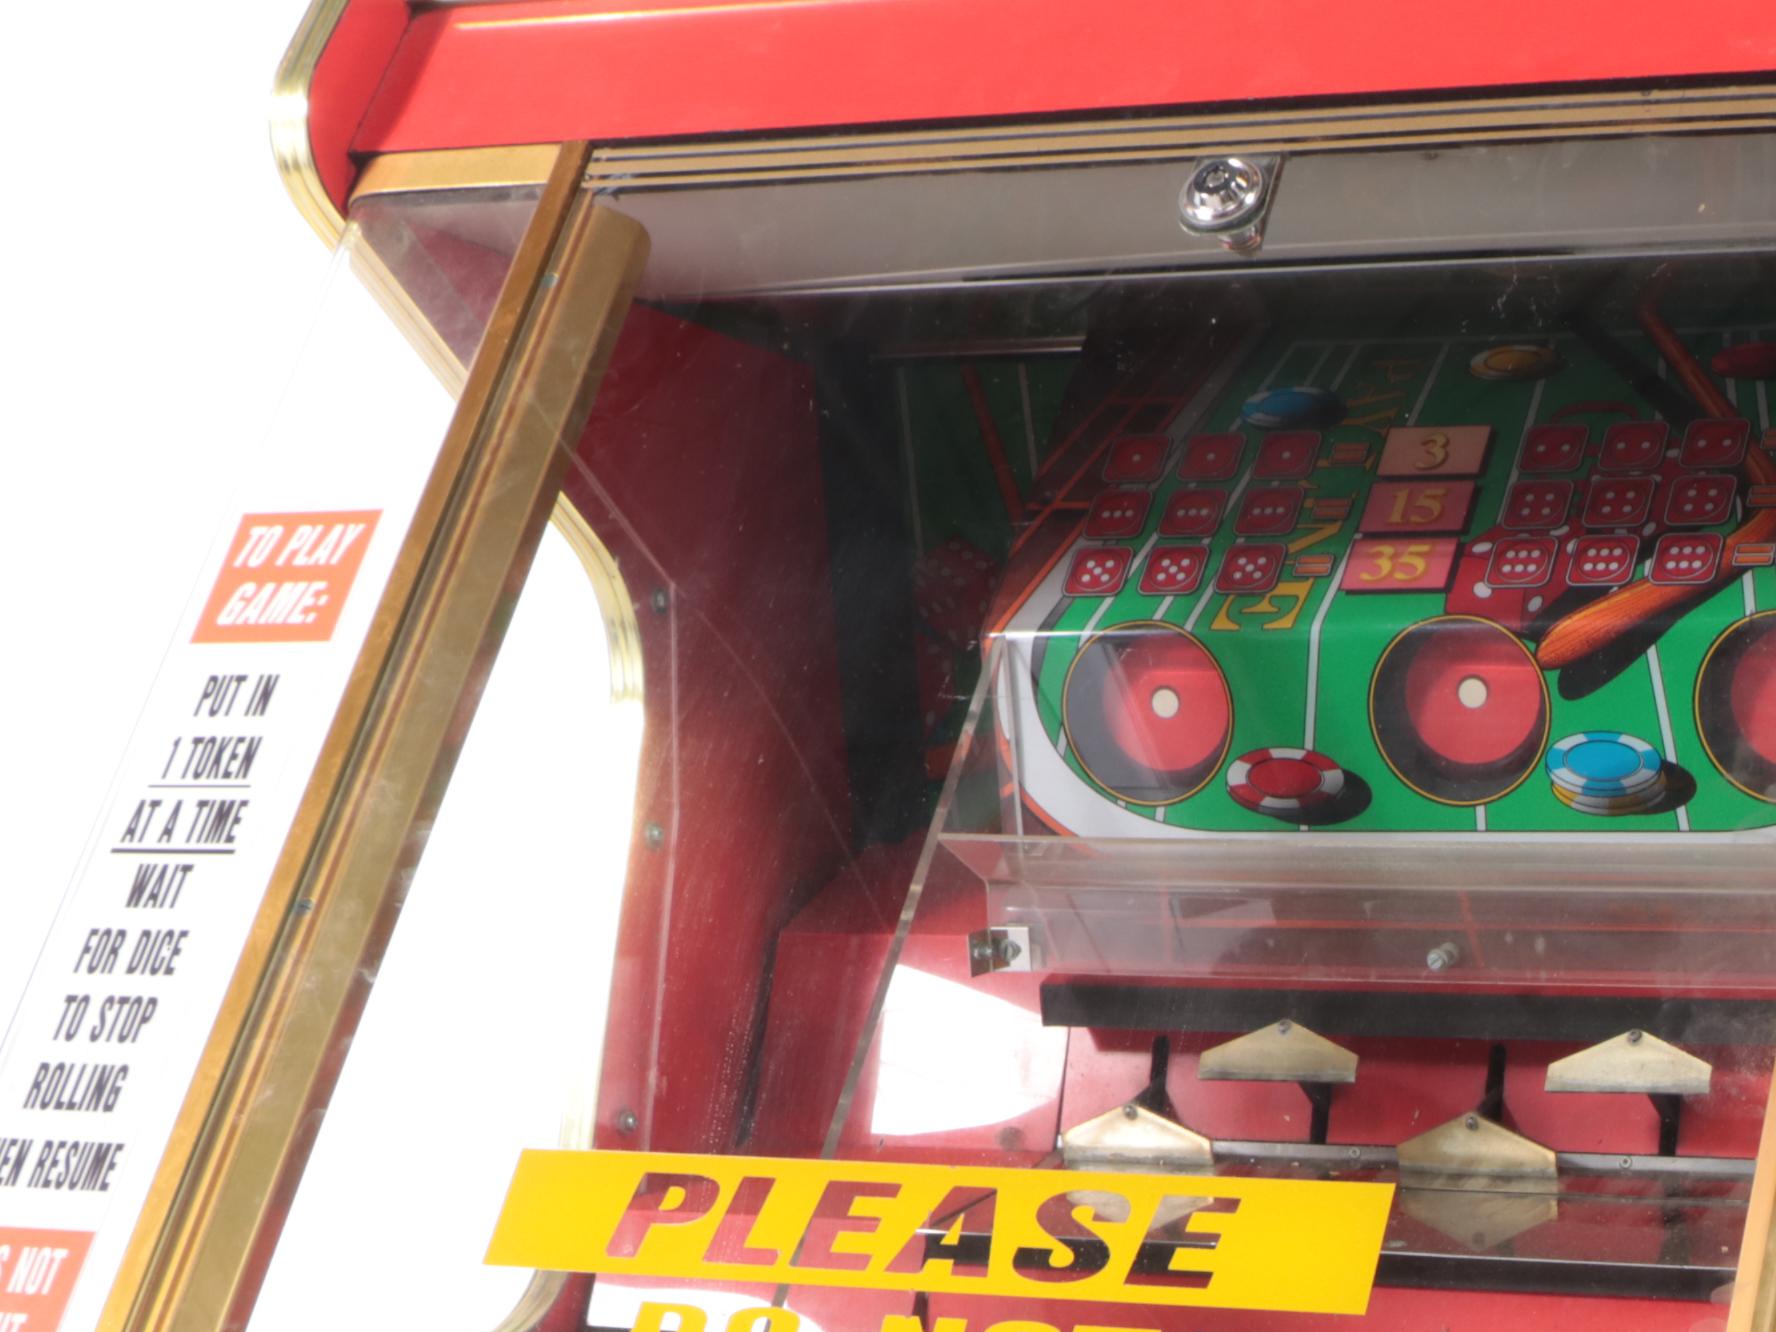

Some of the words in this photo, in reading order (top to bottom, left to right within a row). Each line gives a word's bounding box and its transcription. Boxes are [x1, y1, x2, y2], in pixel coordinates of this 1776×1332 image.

[1413, 431, 1451, 471] 3
[1386, 488, 1447, 525] 15
[232, 525, 285, 568] TO
[274, 523, 367, 567] PLAY
[1358, 543, 1433, 583] 35
[217, 581, 330, 625] GAME:
[193, 674, 249, 717] PUT
[243, 673, 281, 716] IN
[161, 736, 182, 779] 1
[181, 735, 263, 780] TOKEN
[120, 799, 163, 843] AT
[156, 799, 183, 843] A
[185, 799, 250, 843] TIME
[125, 863, 194, 909] WAIT
[73, 928, 127, 976] FOR
[126, 929, 189, 976] DICE
[52, 994, 91, 1042] TO
[89, 995, 158, 1043] STOP
[23, 1062, 129, 1113] ROLLING
[27, 1139, 125, 1192] RESUME
[604, 1171, 1242, 1290] PLEASE
[5, 1245, 70, 1296] NOT
